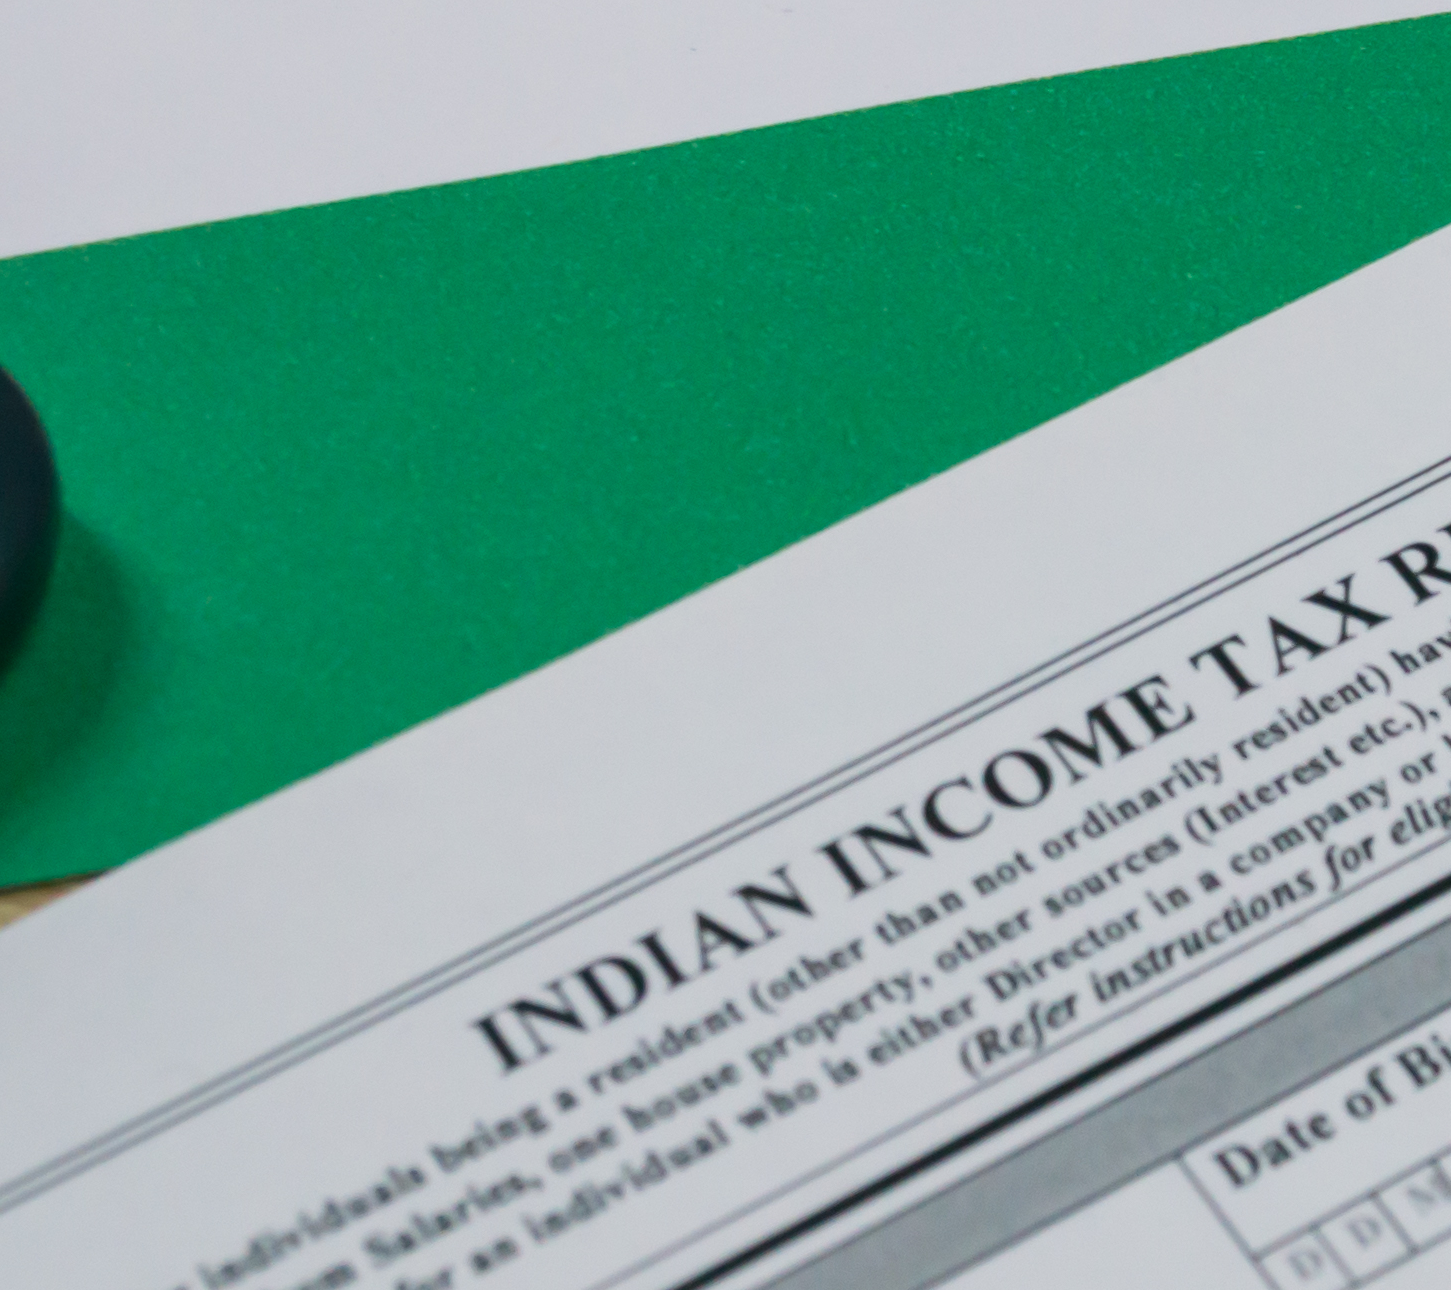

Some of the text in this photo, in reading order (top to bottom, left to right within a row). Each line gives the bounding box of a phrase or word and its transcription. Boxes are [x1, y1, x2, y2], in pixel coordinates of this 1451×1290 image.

[361, 1171, 544, 1263] Salaries,
[545, 1123, 618, 1175] one
[619, 1060, 740, 1134] house
[744, 970, 934, 1079] property,
[932, 905, 1033, 974] other
[1039, 831, 1184, 920] sources
[1180, 742, 1346, 847] (Interest
[1345, 698, 1443, 758] etc.),
[427, 1103, 551, 1174] being
[552, 1087, 581, 1115] a
[584, 998, 746, 1096] resident
[746, 935, 865, 1015] (other
[871, 887, 967, 948] than
[968, 848, 1037, 899] not
[1037, 750, 1225, 862] ordinarily
[1229, 661, 1394, 763] resident)
[467, 1235, 521, 1276] an
[522, 1116, 732, 1244] individual
[734, 1078, 821, 1132] who
[819, 1055, 863, 1089] is
[863, 993, 977, 1068] either
[979, 905, 1143, 1005] Director
[1142, 882, 1194, 919] in
[1194, 867, 1225, 896] a
[1225, 775, 1393, 878] company
[1396, 748, 1439, 787] or
[470, 863, 815, 1074] INDIAN
[816, 671, 1198, 899] INCOME
[1185, 570, 1393, 700] TAX
[955, 989, 1080, 1080] (Refer
[1086, 866, 1319, 1007] instructions
[1320, 832, 1378, 897] for
[1210, 1109, 1338, 1191] Date
[1341, 1062, 1398, 1123] of
